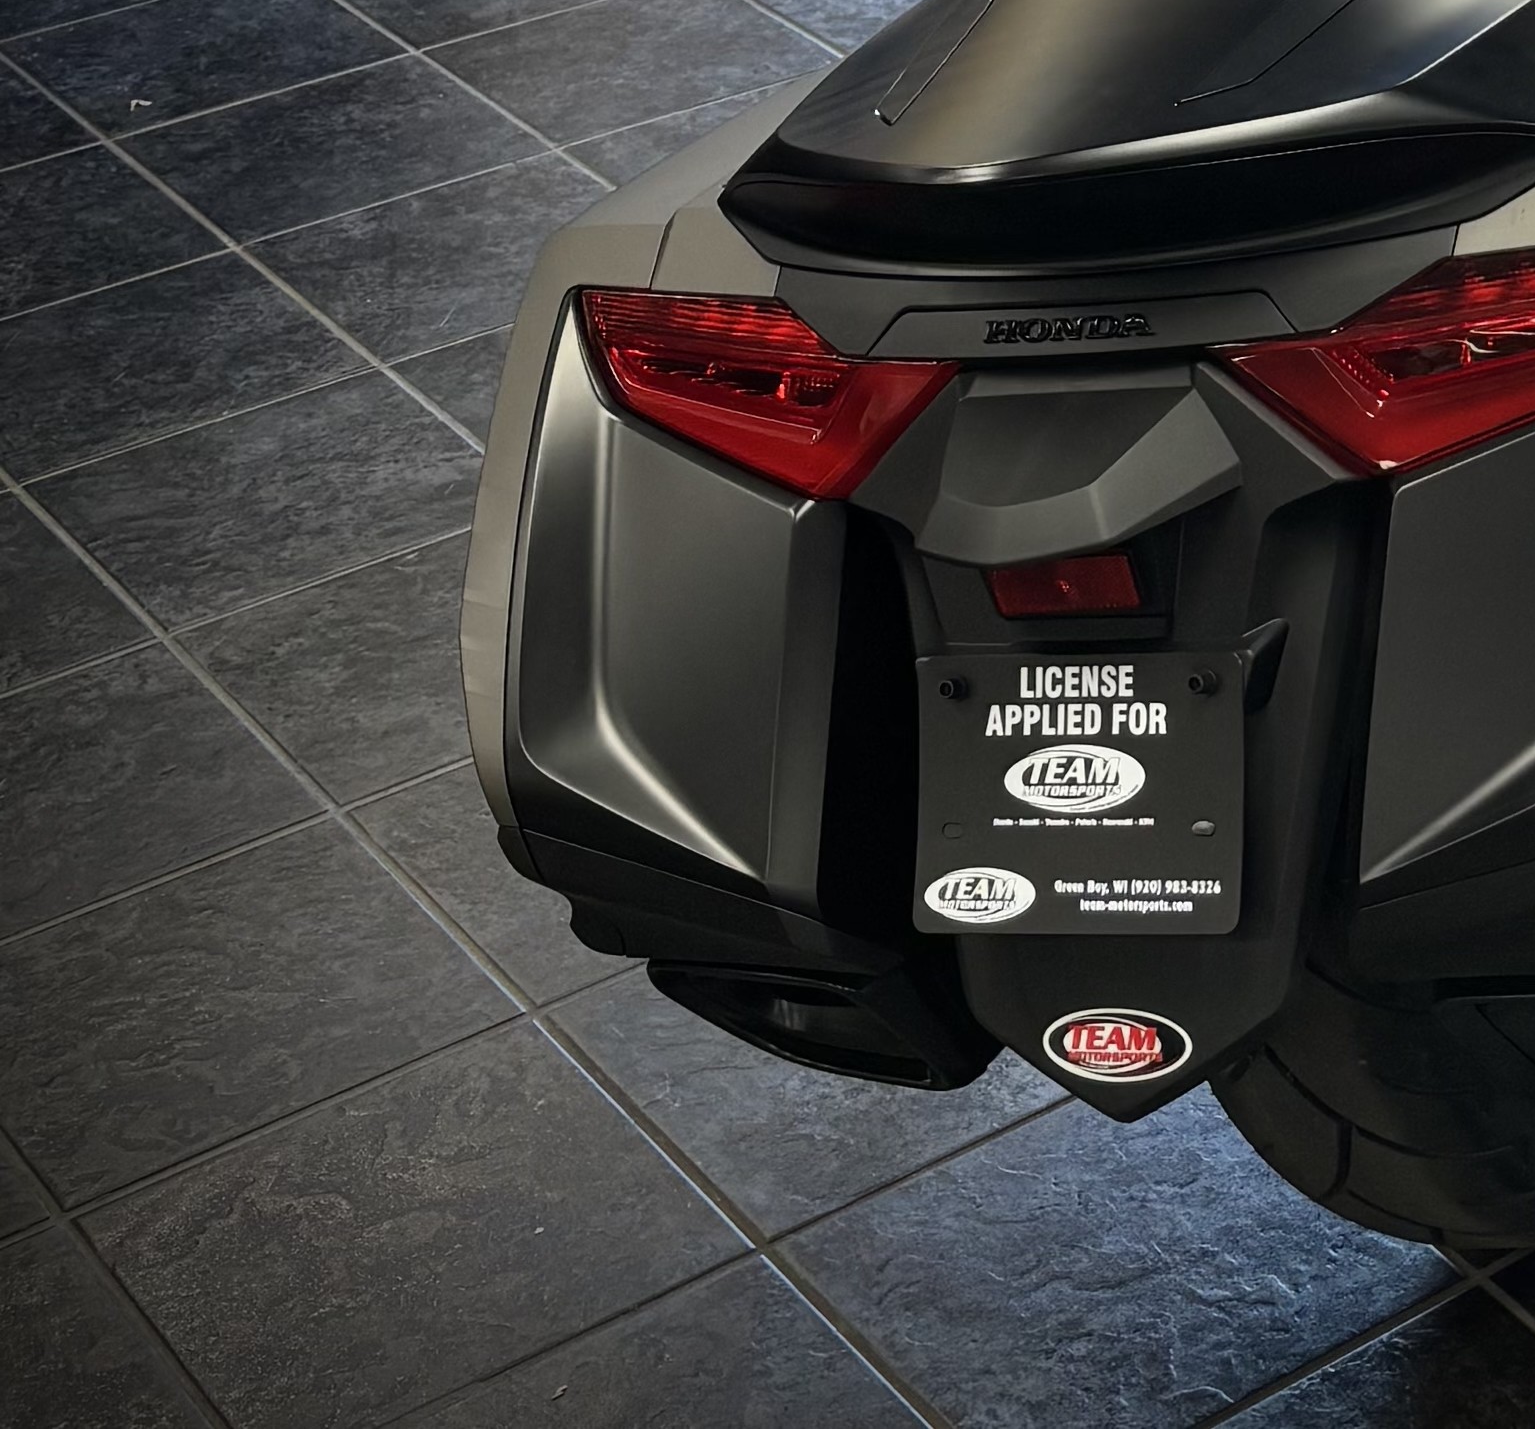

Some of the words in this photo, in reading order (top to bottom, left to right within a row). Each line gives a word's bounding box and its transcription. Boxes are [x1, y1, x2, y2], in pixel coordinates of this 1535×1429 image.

[984, 313, 1156, 344] HONDA
[1020, 665, 1134, 698] LICENSE
[985, 703, 1102, 736] APPLIED
[1112, 702, 1167, 735] FOR
[1029, 757, 1121, 784] TEAM
[1023, 784, 1122, 798] MOTORSPORTS
[941, 878, 1016, 900] TEAM
[1054, 879, 1084, 894] Green
[1113, 880, 1128, 894] WI
[1131, 879, 1162, 895] (920)
[1165, 880, 1221, 894] 983-8326
[1080, 899, 1193, 914] team-motorsports.com
[1067, 1024, 1157, 1051] TEAM
